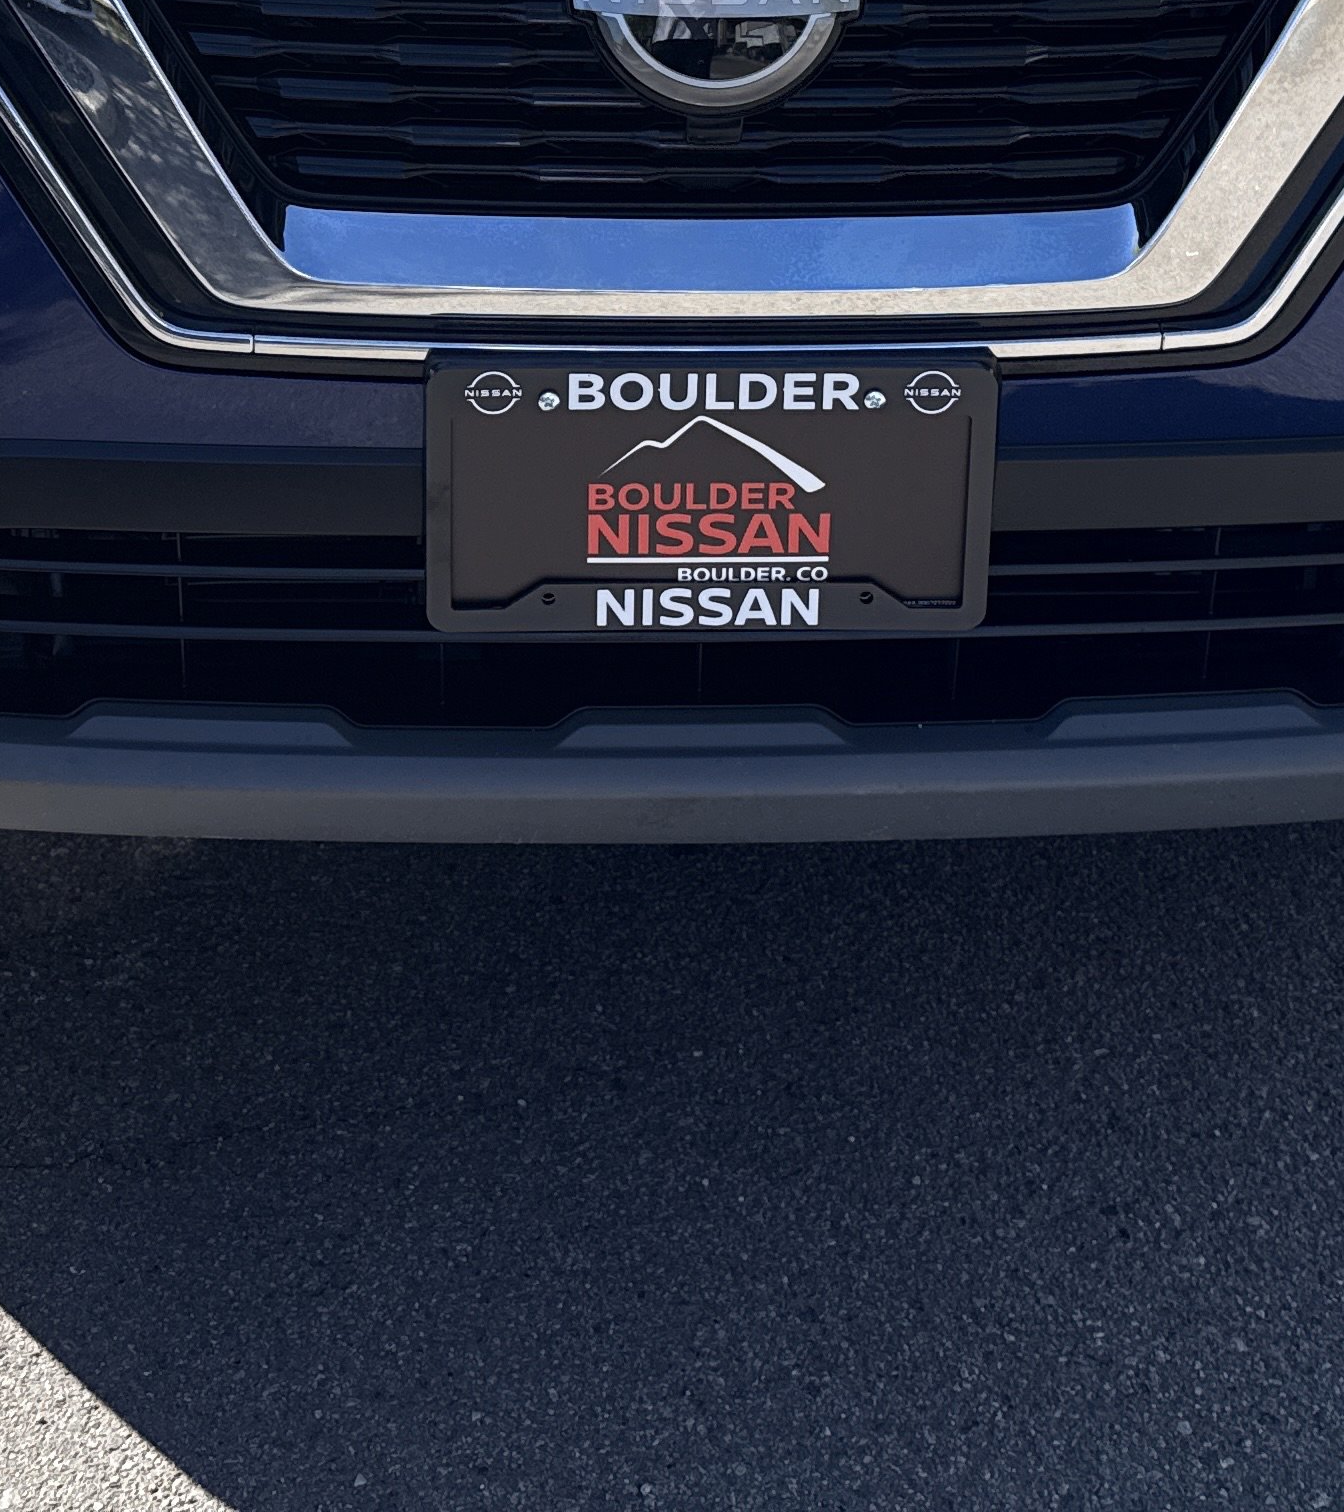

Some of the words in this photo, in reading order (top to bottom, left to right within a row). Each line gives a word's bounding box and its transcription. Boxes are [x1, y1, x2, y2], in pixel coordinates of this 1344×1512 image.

[464, 388, 523, 397] NISSAN
[568, 372, 860, 411] BOULDER
[903, 388, 962, 397] NISSAN
[587, 482, 796, 511] BOULDER
[587, 513, 831, 555] NISSAN
[796, 566, 828, 581] CO
[596, 587, 820, 626] NISSAN
